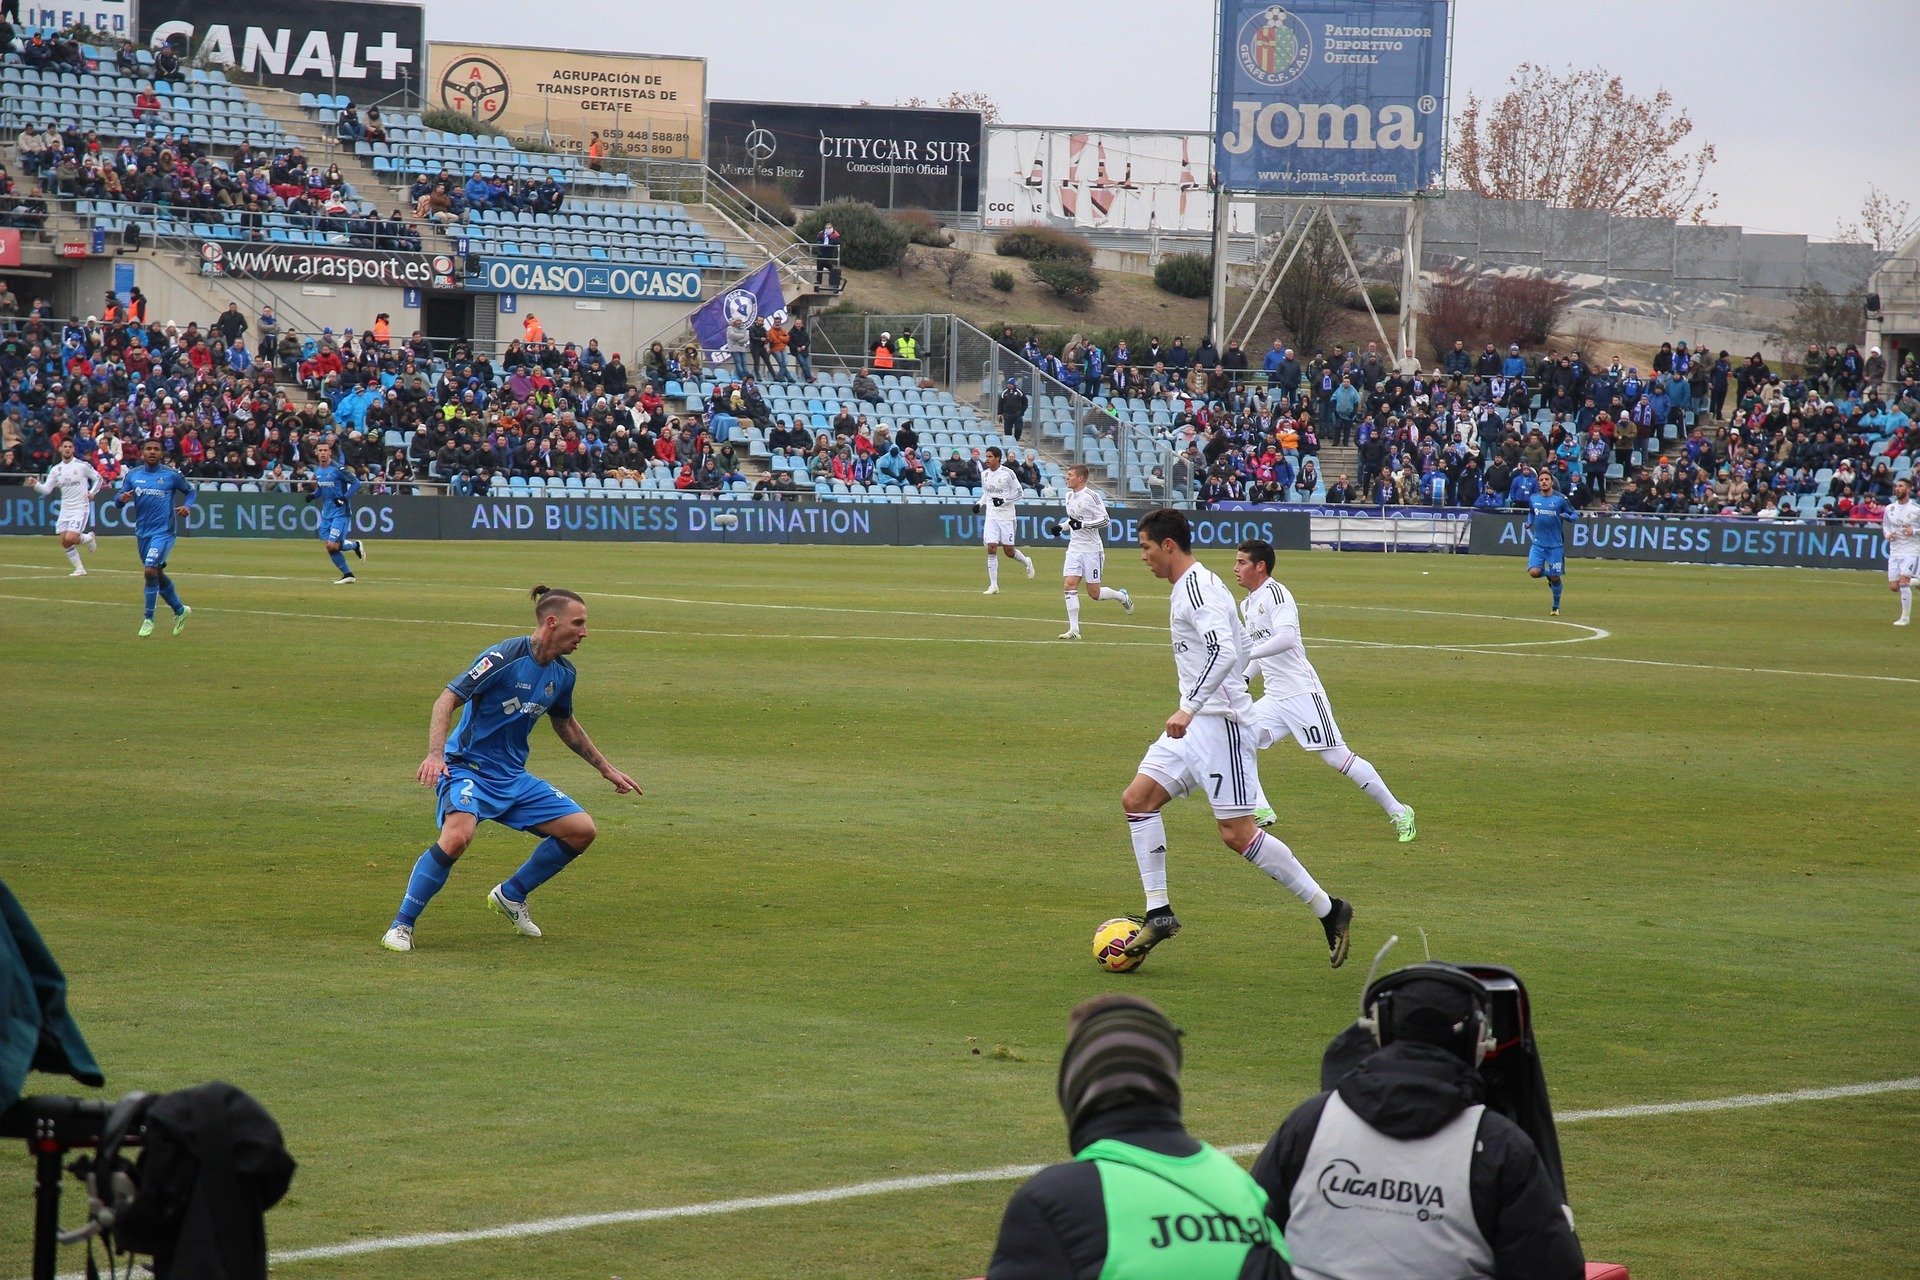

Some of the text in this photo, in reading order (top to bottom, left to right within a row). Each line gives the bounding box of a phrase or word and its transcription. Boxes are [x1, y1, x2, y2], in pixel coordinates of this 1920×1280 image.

[1240, 44, 1266, 80] GETAFE
[552, 69, 663, 86] AGRUPACIÓN DE
[536, 83, 678, 101] TRANSPORTISTAS DE
[580, 100, 633, 113] GETAFE
[603, 129, 624, 139] 659
[627, 130, 648, 140] 448
[626, 143, 648, 153] 953
[651, 145, 673, 154] 890
[819, 137, 972, 163] CITYCAR SUR
[719, 163, 804, 178] Mercees Benz
[846, 161, 948, 176] Concesionario Oficial
[1257, 169, 1397, 184] www.joma-sport.com
[226, 249, 431, 284] www.arasport.es
[490, 262, 584, 293] OCASO
[609, 264, 702, 298] OCASO
[185, 503, 225, 531] DE
[471, 503, 870, 534] AND BUSINESS DESTINATION
[1107, 518, 1138, 542] DE
[1572, 523, 1712, 552] BUSINESS
[1302, 725, 1322, 744] 10
[460, 779, 474, 797] 2
[1209, 773, 1223, 799] 7
[1154, 917, 1173, 927] CR7
